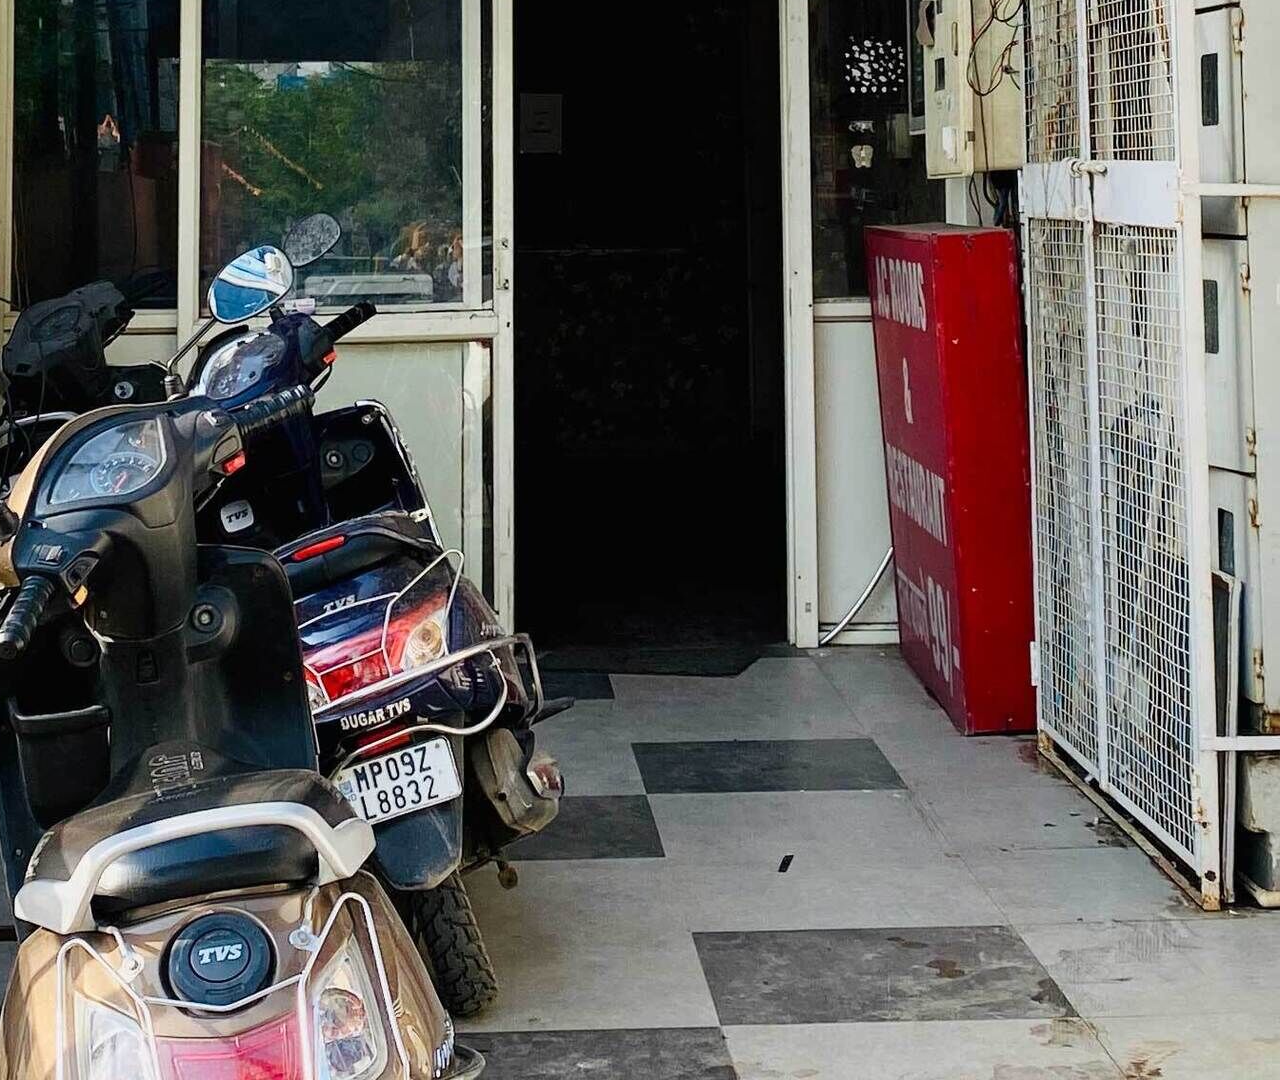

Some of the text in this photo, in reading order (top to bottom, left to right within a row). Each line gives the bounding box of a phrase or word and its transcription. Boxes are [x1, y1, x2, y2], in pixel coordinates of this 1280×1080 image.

[874, 255, 927, 332] AC ROOMS
[902, 357, 913, 424] &
[226, 509, 249, 523] TVS
[323, 594, 357, 613] TVS
[340, 698, 411, 730] DUGAR TVS
[353, 746, 431, 792] MP09Z
[361, 775, 439, 820] L8832
[199, 943, 243, 965] TVS
